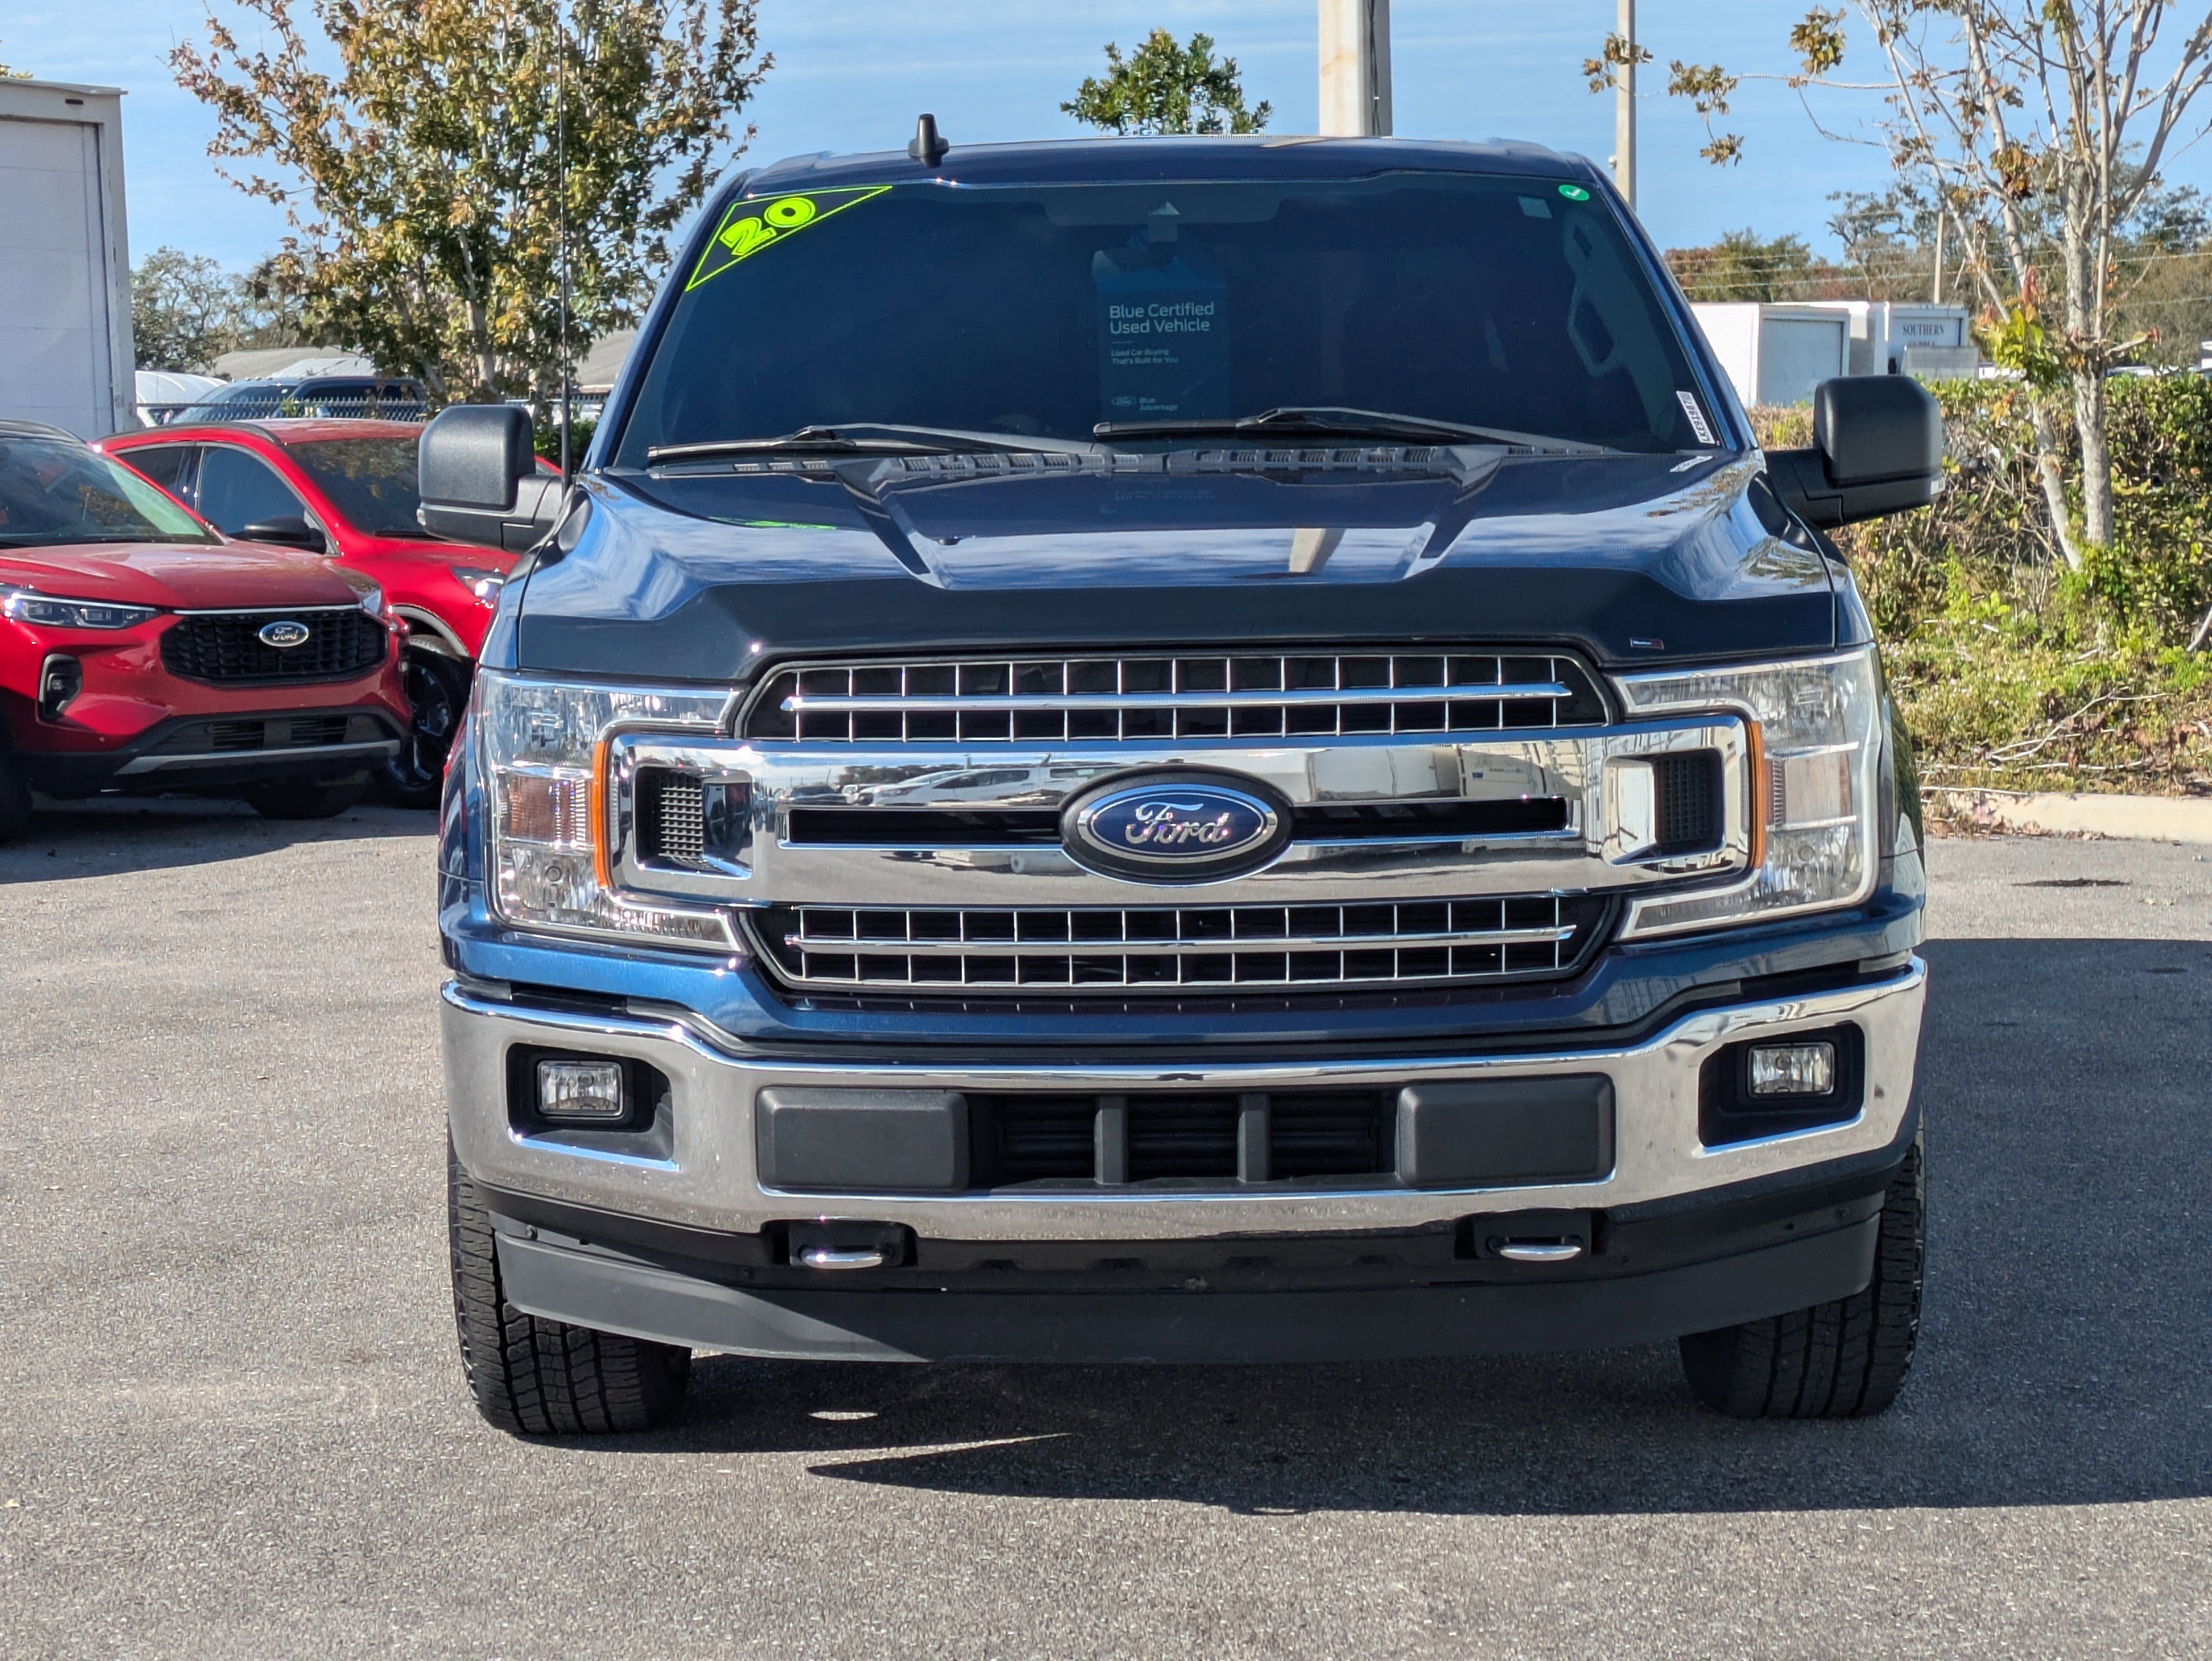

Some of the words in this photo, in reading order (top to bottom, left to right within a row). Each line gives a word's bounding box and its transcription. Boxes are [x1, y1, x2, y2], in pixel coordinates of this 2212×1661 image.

[719, 197, 816, 255] 20
[1109, 304, 1144, 318] Blue
[1148, 301, 1215, 317] Certified
[1110, 320, 1150, 334] Used
[1154, 317, 1210, 332] Vehicle
[1902, 324, 1945, 335] SOUTHERN
[272, 627, 299, 641] Ford
[1125, 801, 1230, 844] Ford
